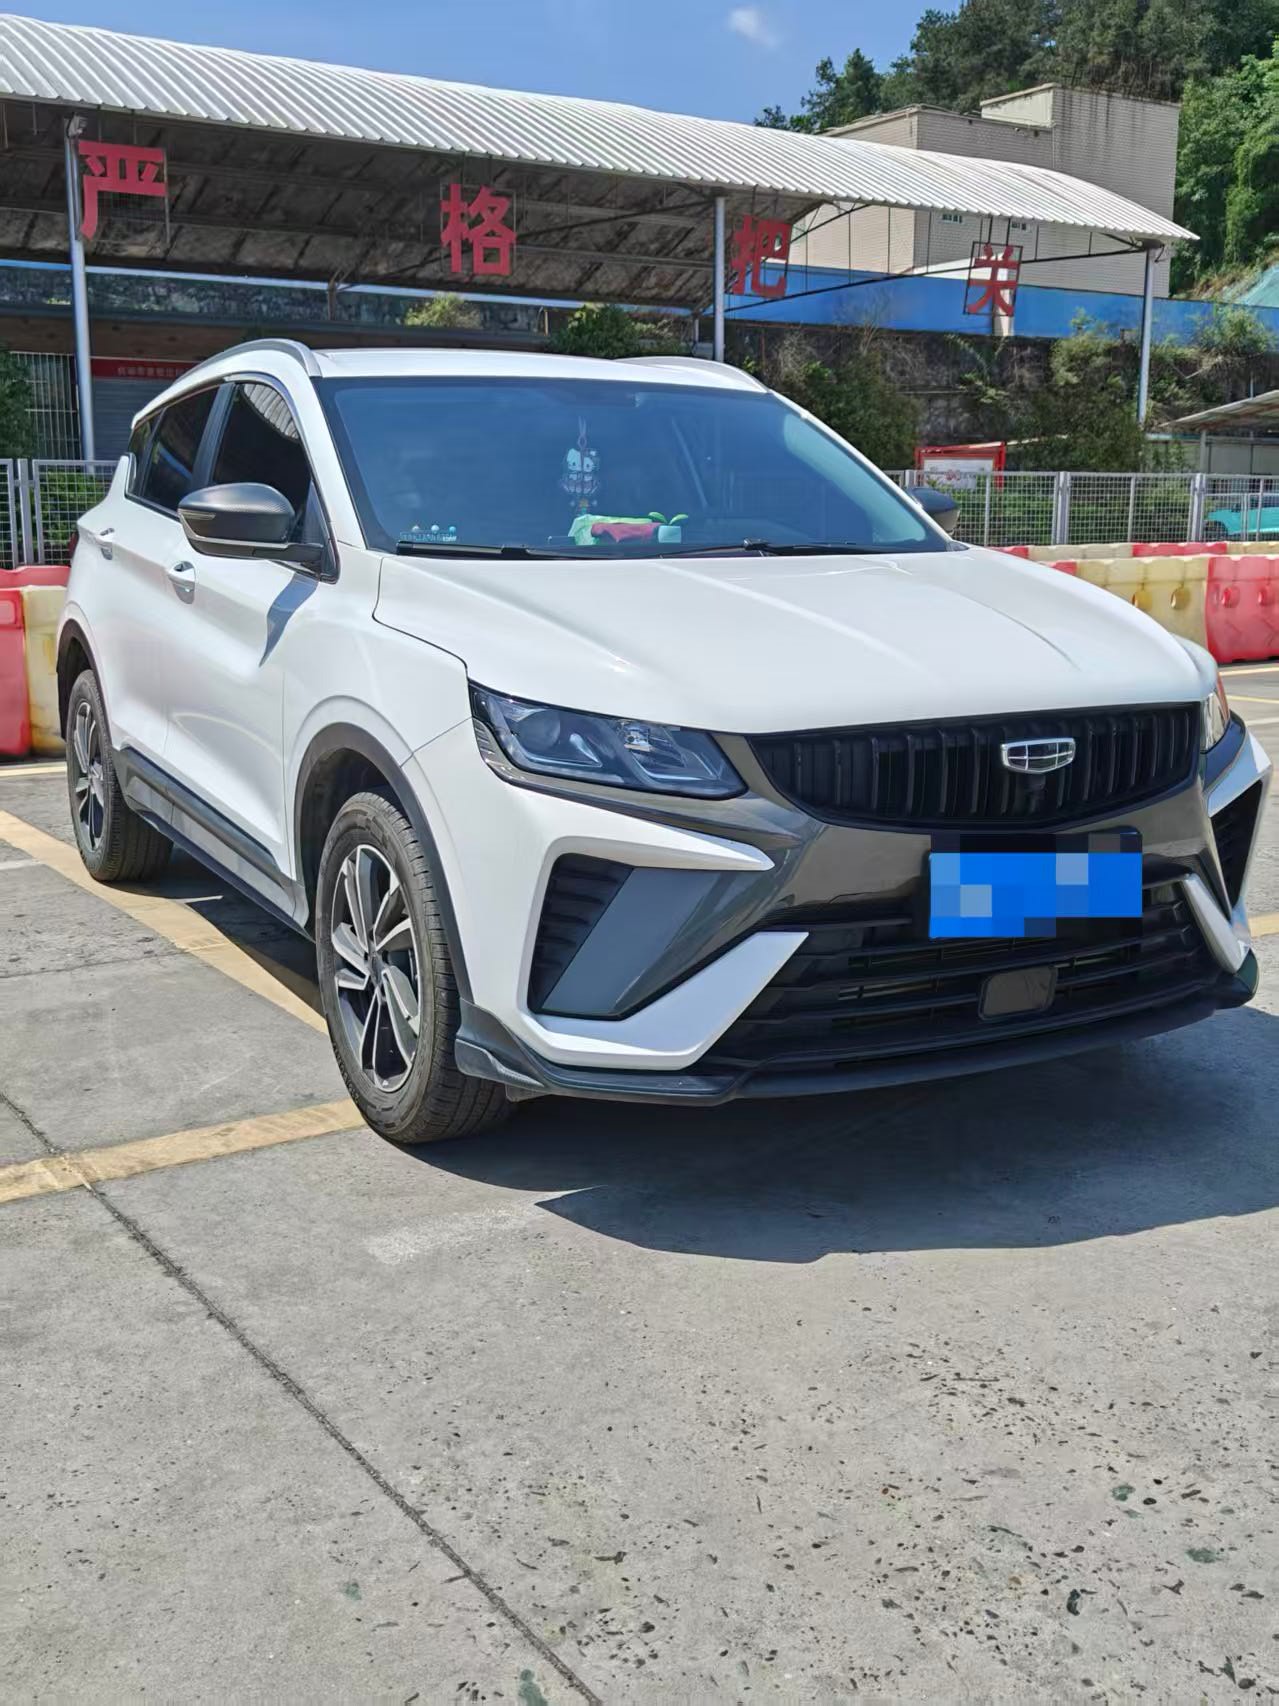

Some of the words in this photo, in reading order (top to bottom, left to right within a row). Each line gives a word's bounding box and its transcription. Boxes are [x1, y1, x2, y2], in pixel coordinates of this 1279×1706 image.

[79, 141, 166, 240] 严
[440, 184, 516, 276] 格
[729, 214, 793, 299] 把
[966, 243, 1019, 316] 关
